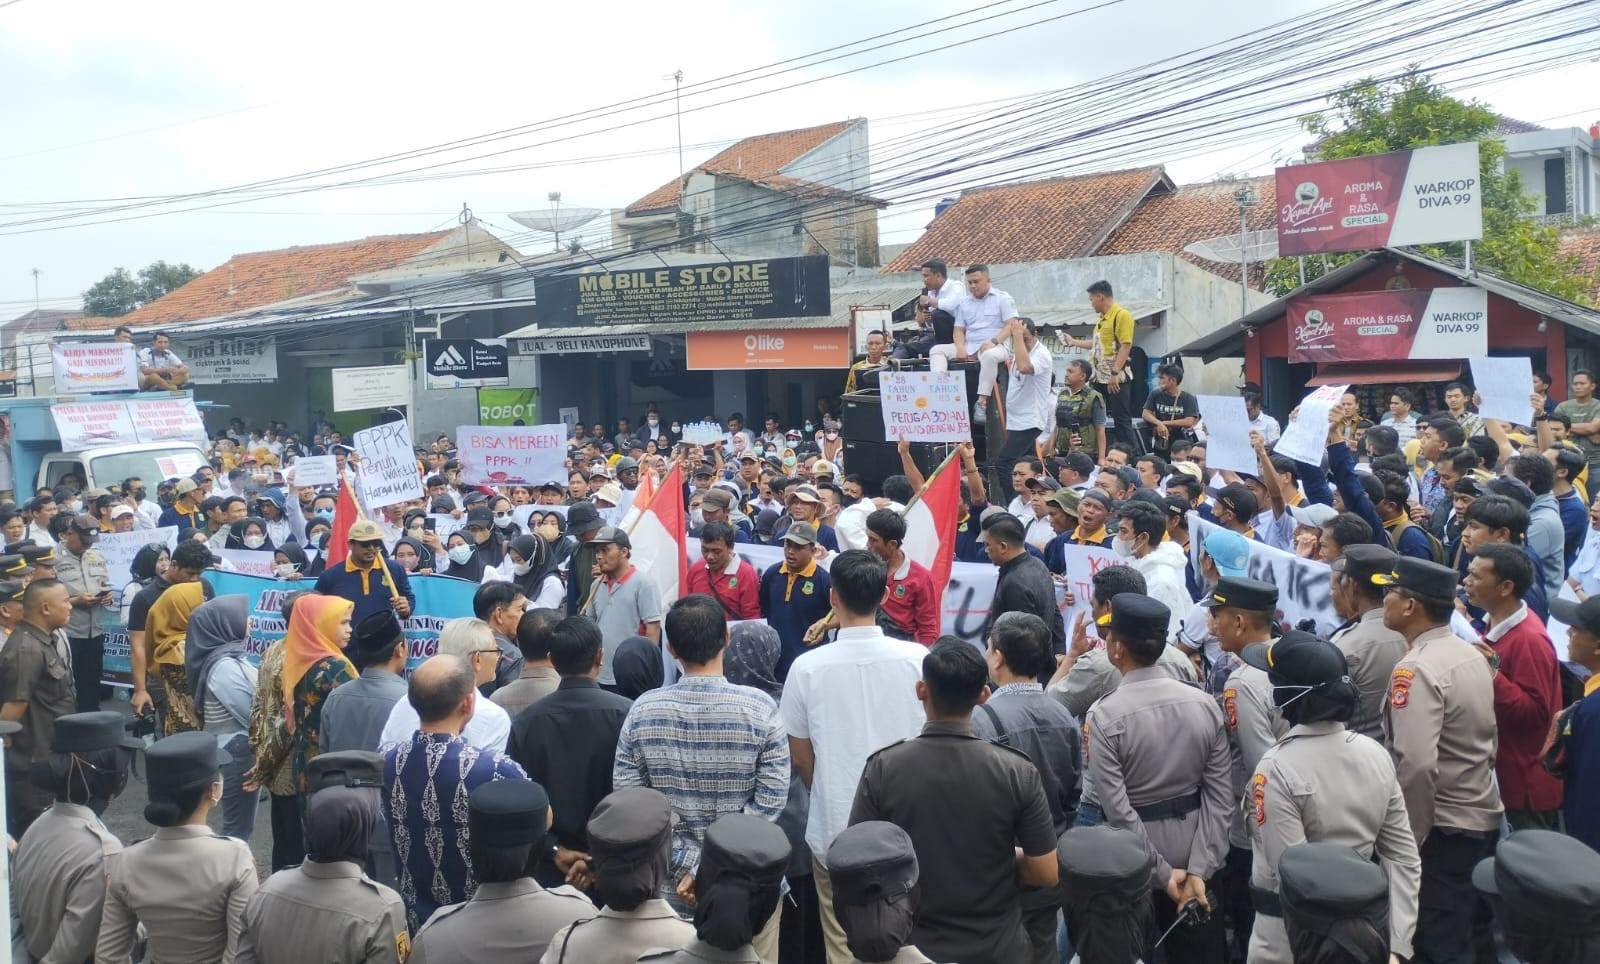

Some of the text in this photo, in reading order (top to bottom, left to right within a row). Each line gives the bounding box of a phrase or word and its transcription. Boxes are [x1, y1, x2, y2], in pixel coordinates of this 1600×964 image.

[1344, 181, 1383, 195] AROMA
[1414, 178, 1475, 195] WARKOP
[1359, 192, 1368, 203] &
[1419, 193, 1471, 209] DIVA 99
[1282, 197, 1333, 224] Kapal Api
[1349, 203, 1379, 214] RASA
[1345, 215, 1385, 226] SPECIAL
[680, 262, 768, 285] STORE
[734, 280, 769, 288] SECOND
[622, 293, 660, 301] VOUCHER
[667, 290, 724, 298] ACCESSORIES
[731, 286, 769, 295] SERVICE
[1344, 314, 1413, 325] AROMA & RASA
[1433, 312, 1483, 322] WARKOP
[1361, 326, 1394, 334] SPECIAL
[1436, 322, 1480, 334] DIVA 99
[521, 341, 547, 352] JUAL
[556, 340, 577, 351] BELI
[581, 337, 646, 350] HANDPHONE
[480, 403, 537, 420] ROBOT
[359, 424, 408, 456] PPPK
[471, 434, 559, 450] BISA MEREEN
[360, 454, 398, 477] Penuh
[485, 455, 518, 467] PPPK
